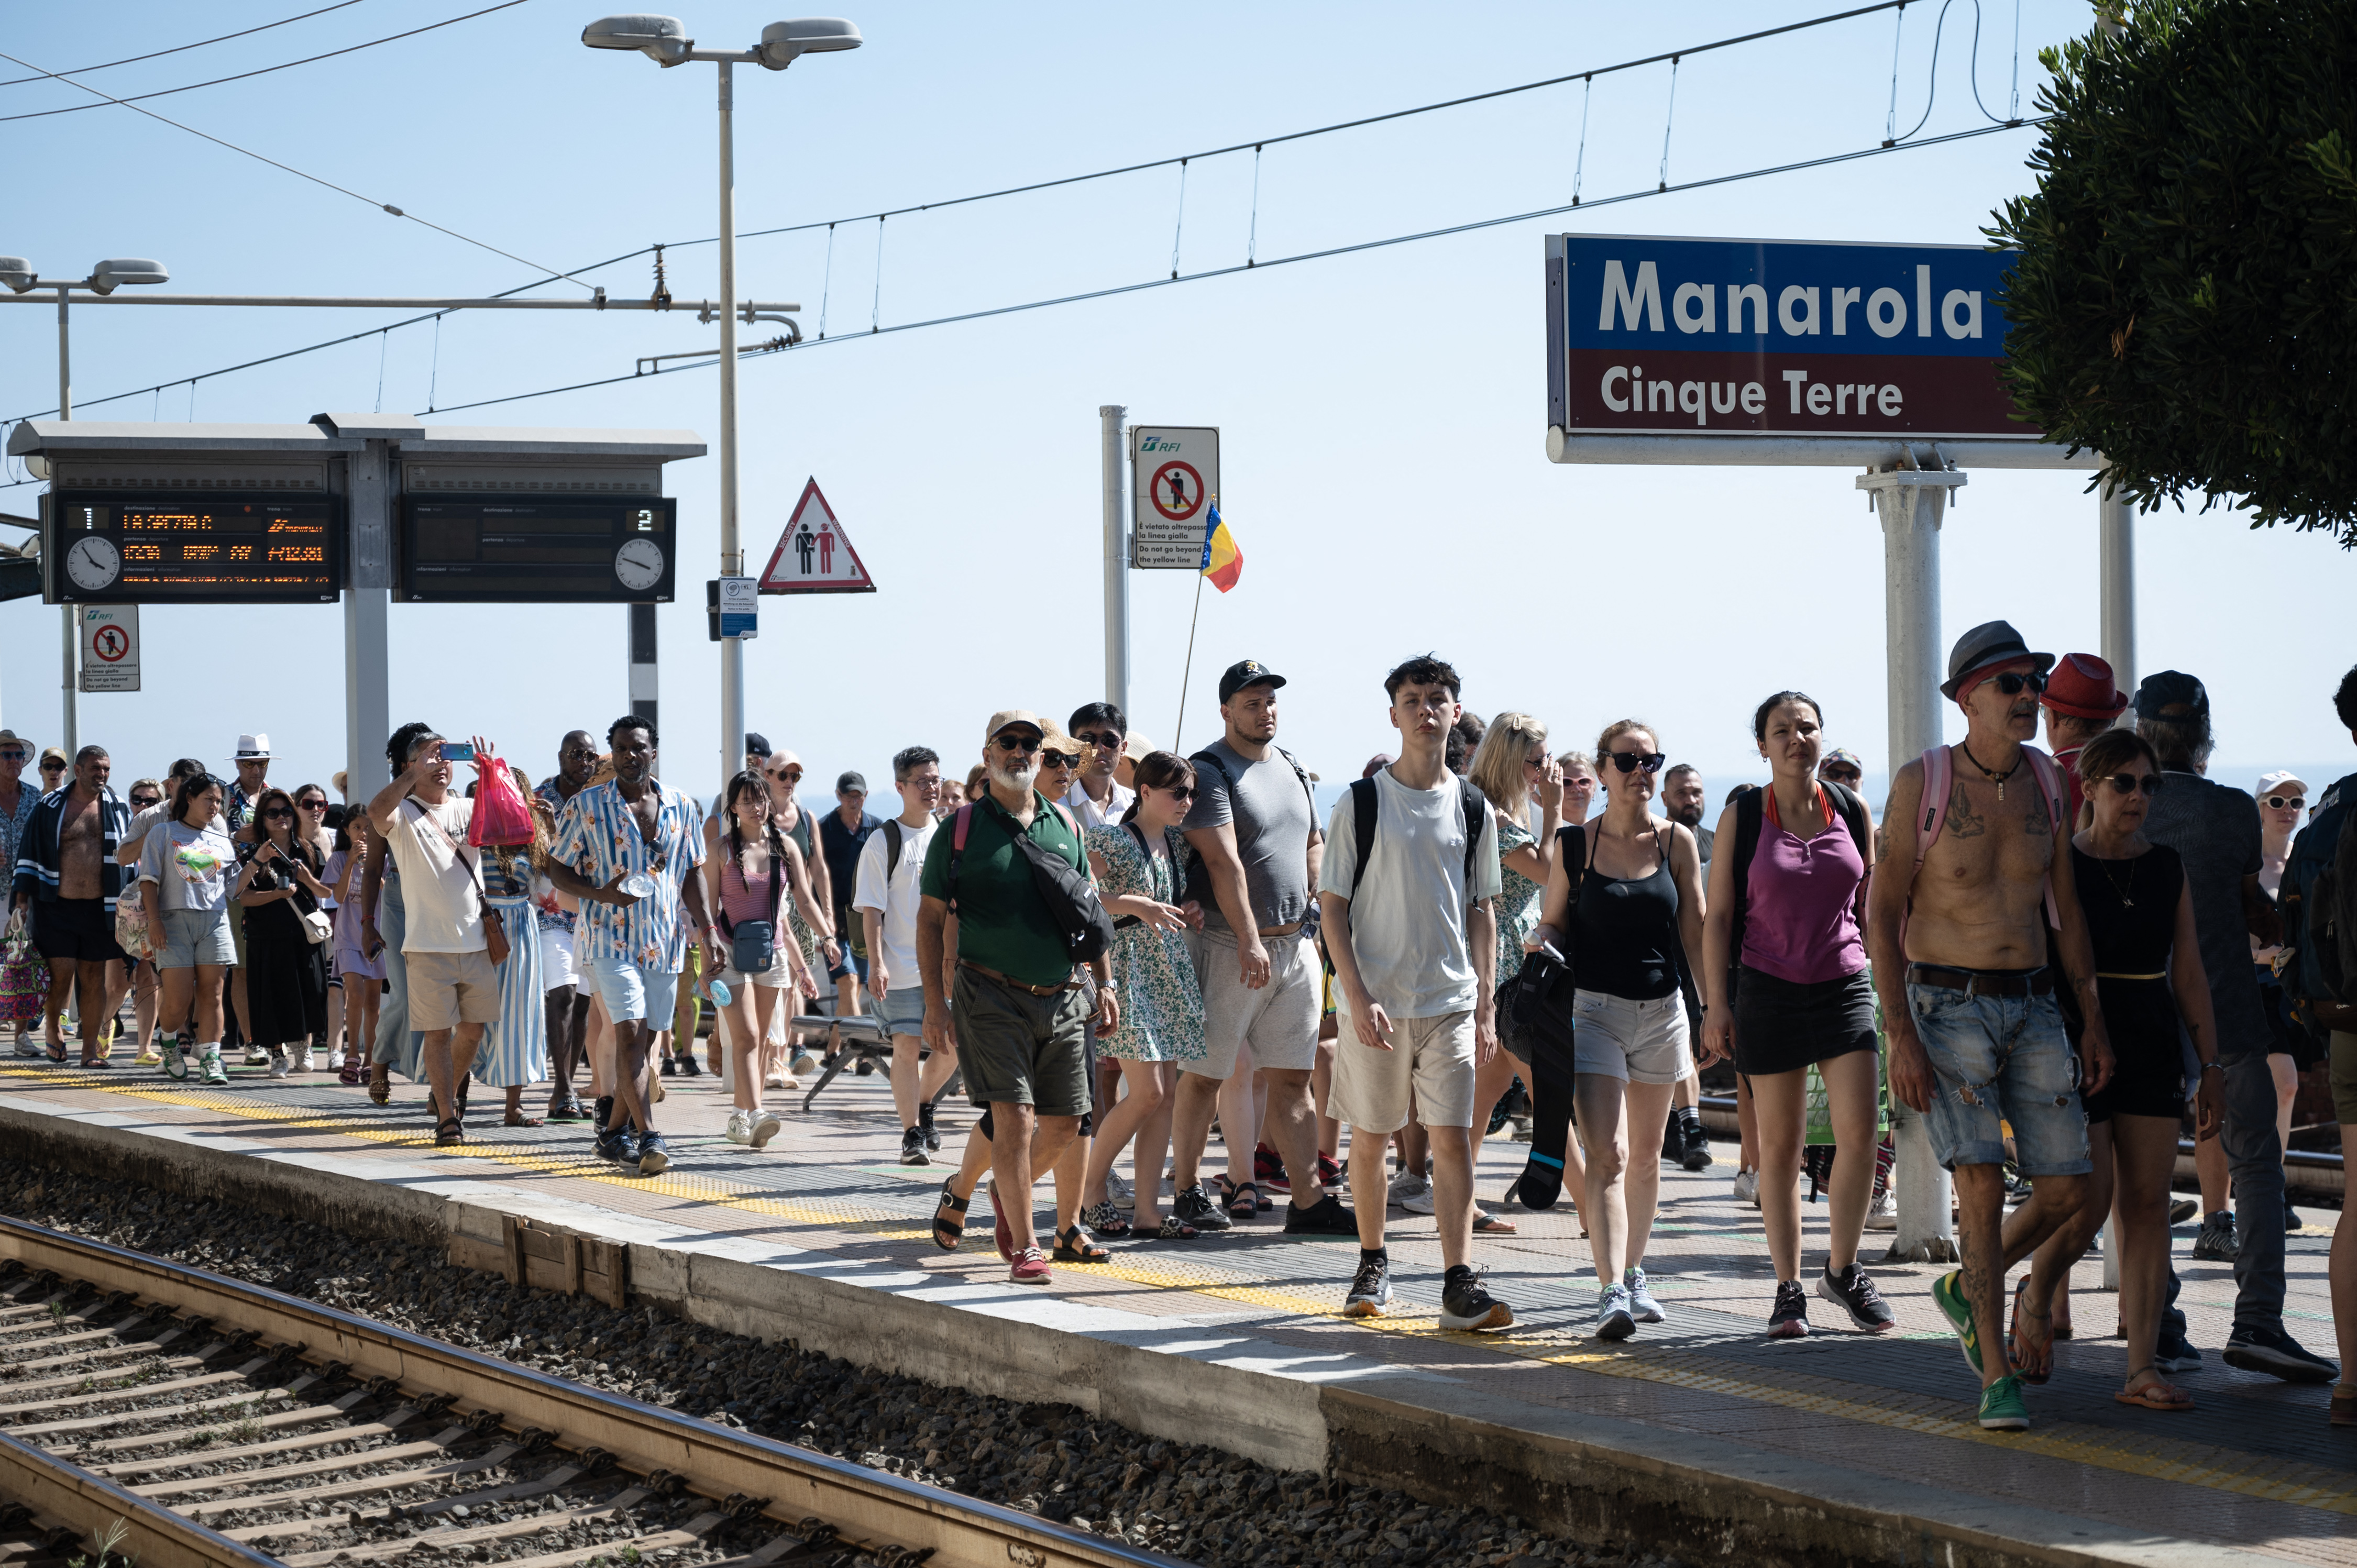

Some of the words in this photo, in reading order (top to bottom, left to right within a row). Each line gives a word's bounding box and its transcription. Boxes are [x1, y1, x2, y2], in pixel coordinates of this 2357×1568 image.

[1599, 259, 1983, 340] Manarola
[1601, 365, 1767, 426] Cinque
[1782, 369, 1904, 417] Terre
[1159, 443, 1181, 452] RFI
[84, 508, 92, 529] 1
[638, 510, 652, 531] 2
[1139, 521, 1143, 529] È
[1171, 523, 1206, 532] oltrepassa
[779, 521, 796, 549] SECURITY
[832, 518, 851, 548] WARNING
[1168, 532, 1188, 540] gialla
[1175, 546, 1202, 554] beyond
